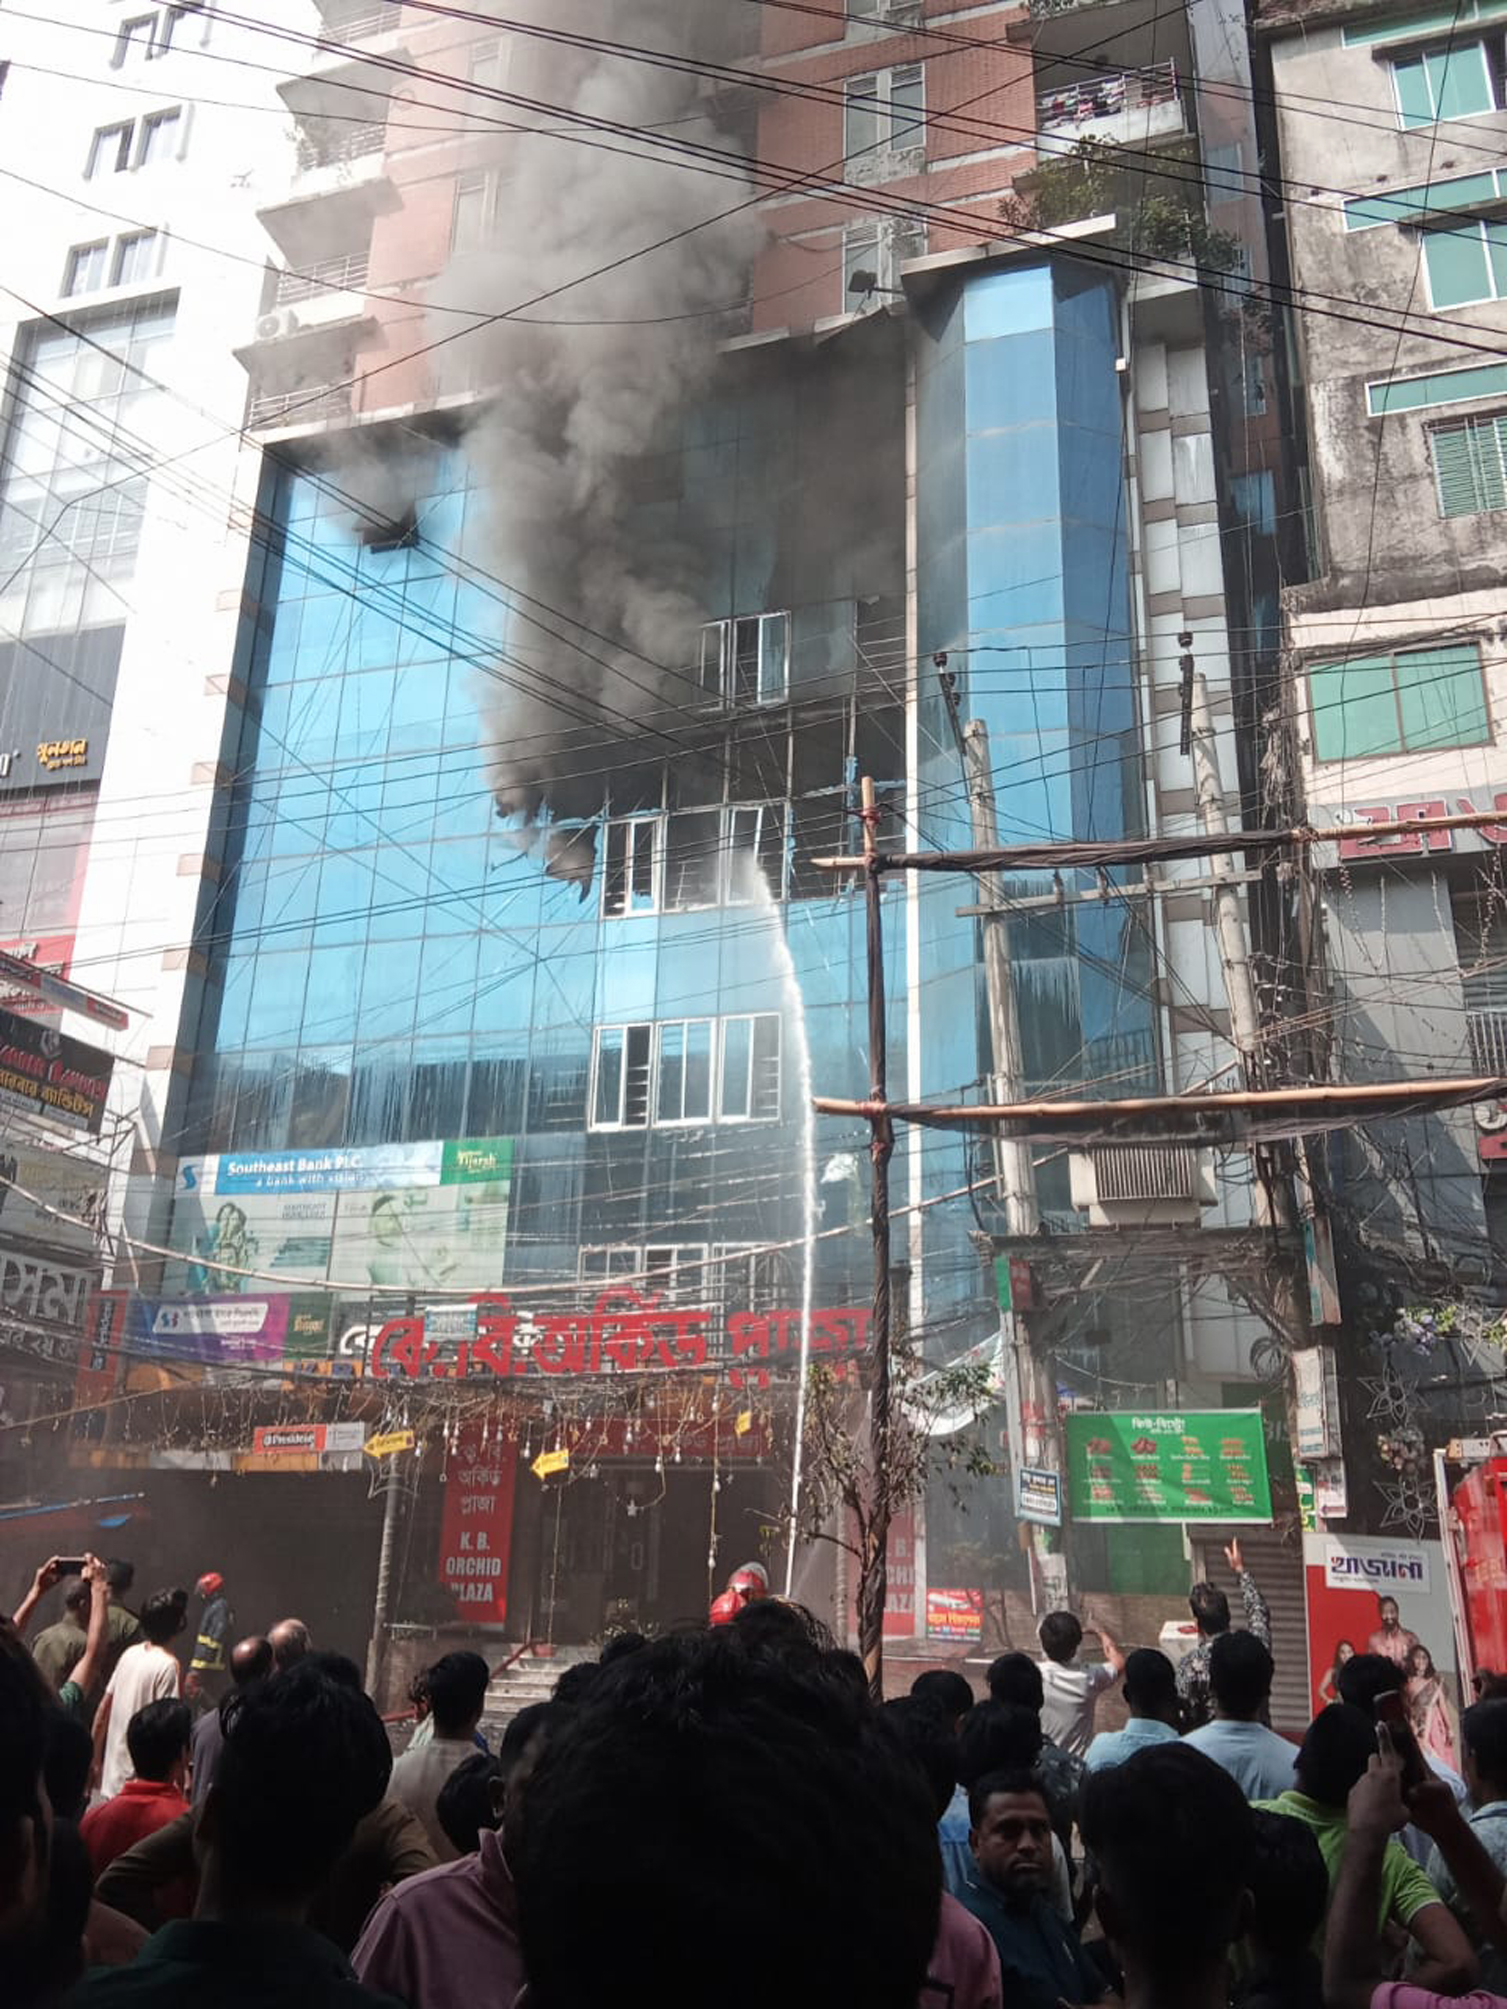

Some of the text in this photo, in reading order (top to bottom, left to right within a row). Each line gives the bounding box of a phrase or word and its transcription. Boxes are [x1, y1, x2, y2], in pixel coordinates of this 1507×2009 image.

[227, 1157, 294, 1176] Southeast
[297, 1156, 332, 1172] Bank
[265, 1175, 293, 1187] bank
[460, 1531, 490, 1550] K. B.
[446, 1556, 502, 1577] ORCHID
